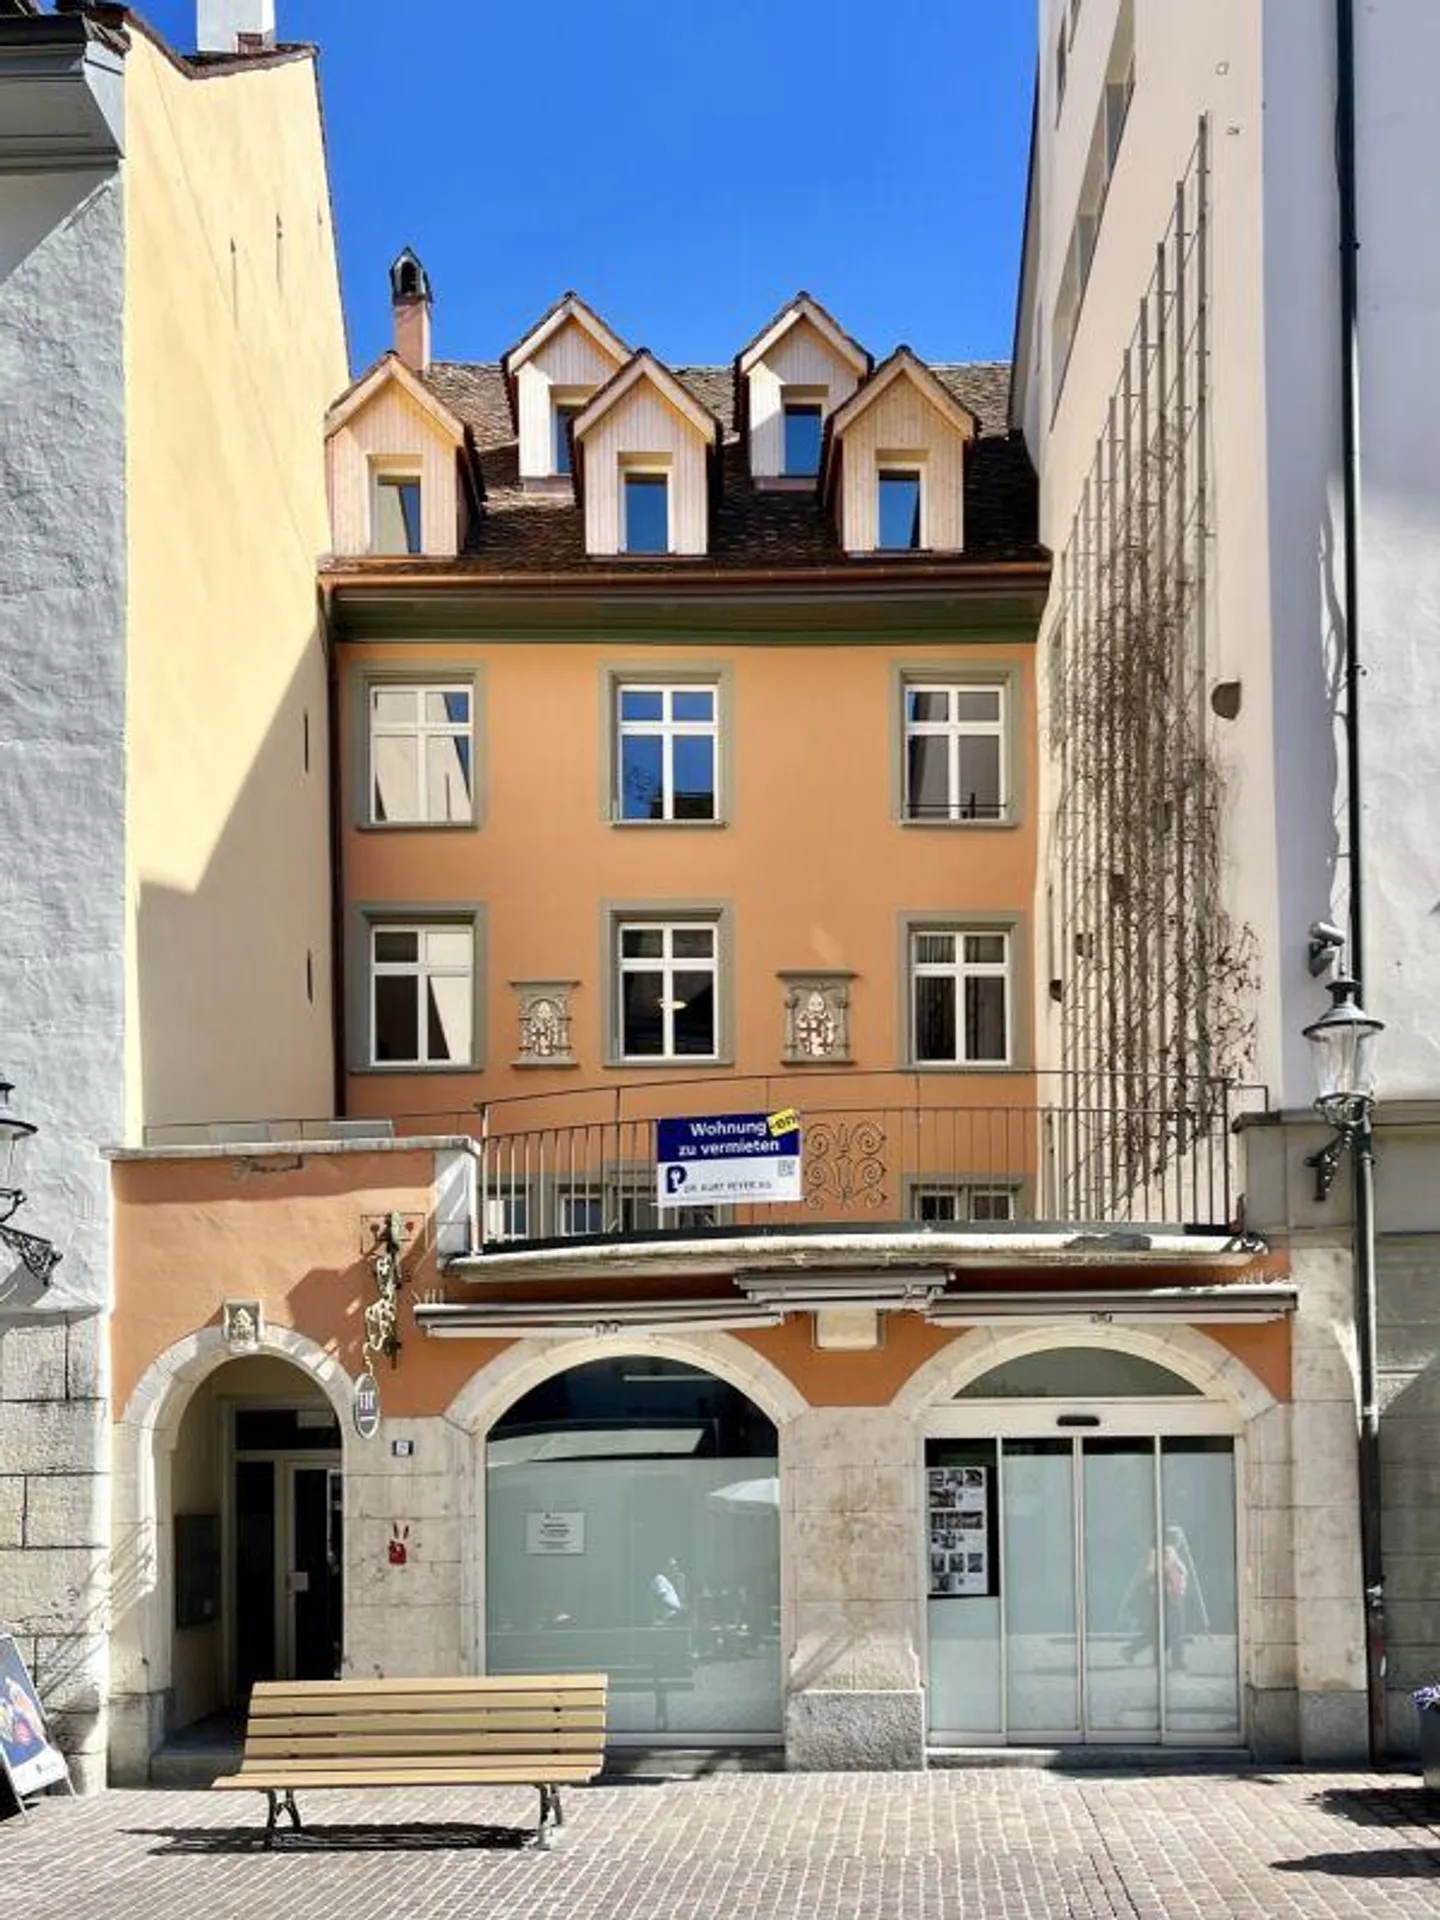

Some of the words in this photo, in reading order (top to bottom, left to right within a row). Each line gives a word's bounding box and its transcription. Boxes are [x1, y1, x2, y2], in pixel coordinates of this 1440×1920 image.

[689, 1120, 766, 1137] Wohnung
[678, 1144, 697, 1156] zu
[701, 1139, 780, 1155] vermieten
